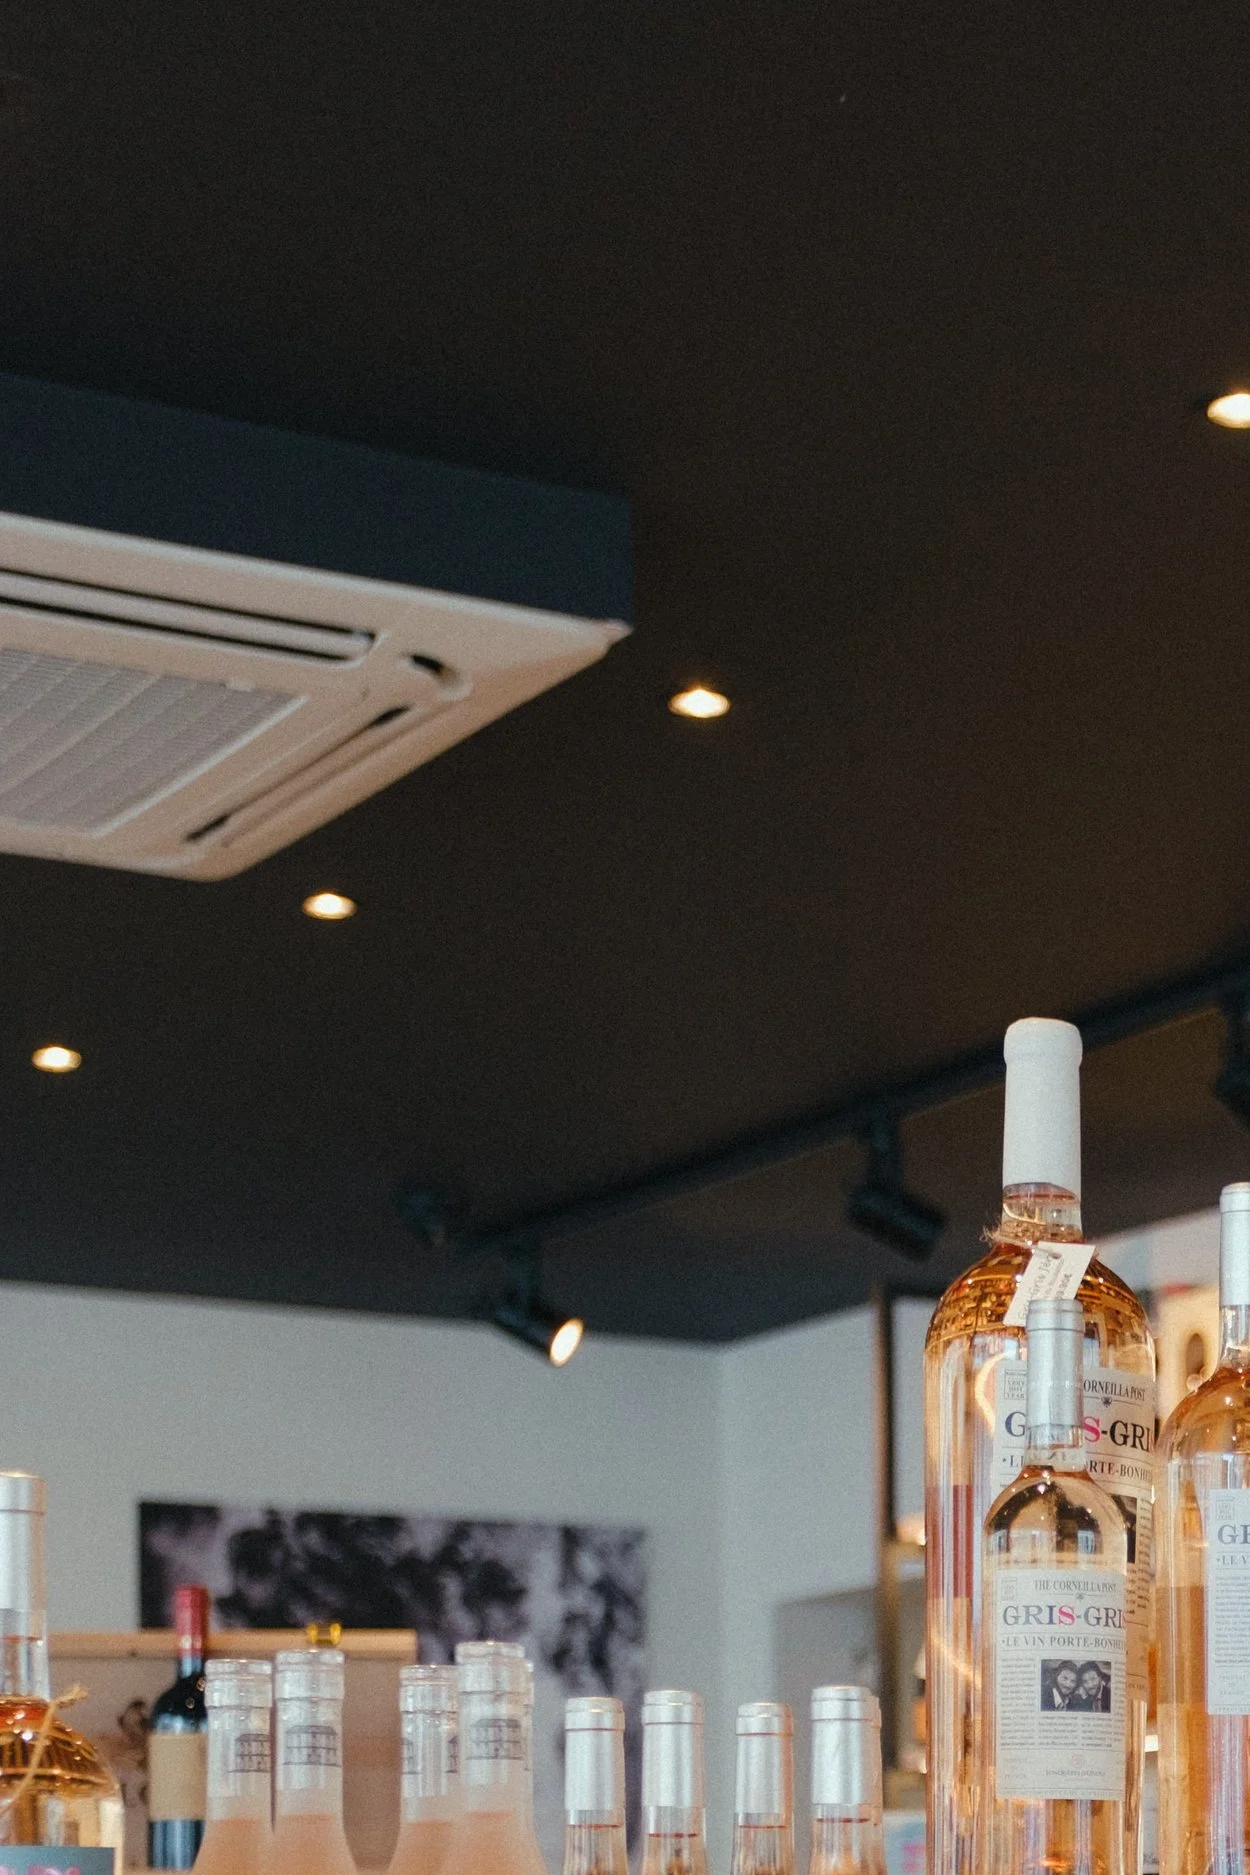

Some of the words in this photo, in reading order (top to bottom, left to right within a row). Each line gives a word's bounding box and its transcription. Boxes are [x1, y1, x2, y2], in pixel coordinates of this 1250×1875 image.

[1083, 1379, 1129, 1398] ORNEILLA
[1034, 1579, 1050, 1591] THE
[1053, 1580, 1101, 1593] CORNEILLA
[1024, 1636, 1045, 1646] VIN
